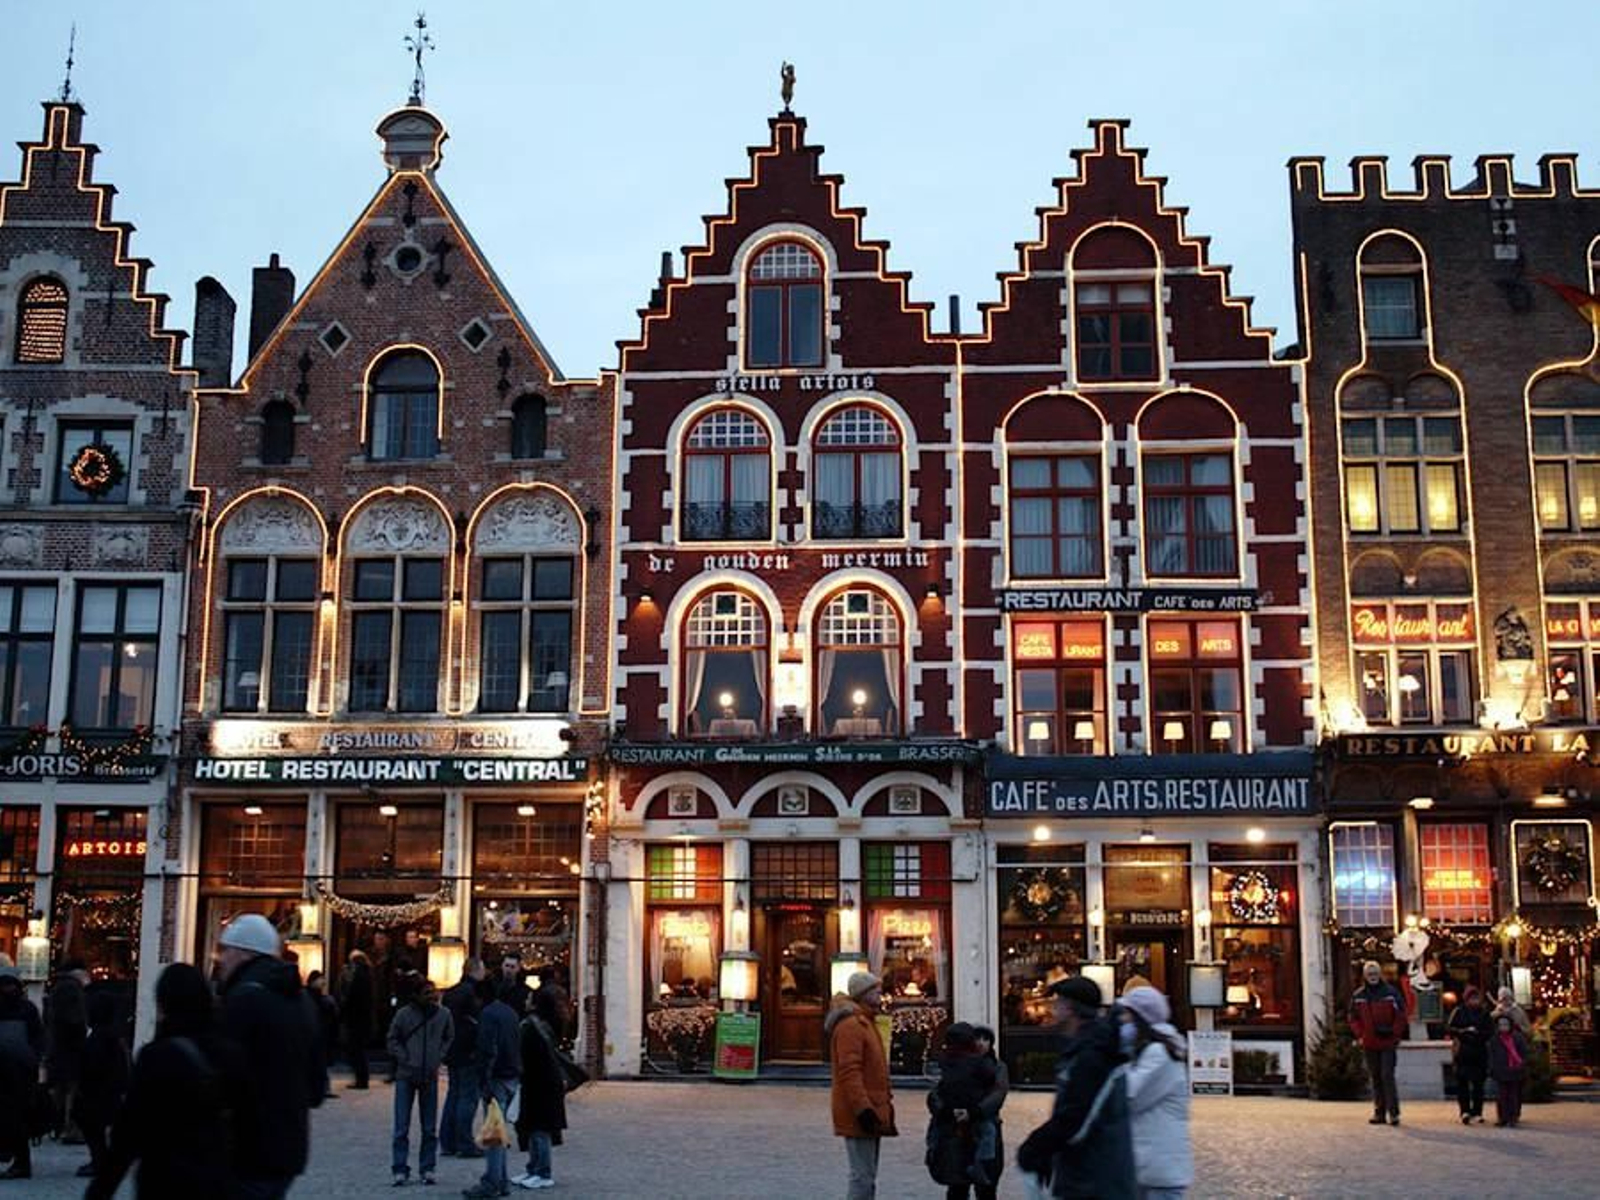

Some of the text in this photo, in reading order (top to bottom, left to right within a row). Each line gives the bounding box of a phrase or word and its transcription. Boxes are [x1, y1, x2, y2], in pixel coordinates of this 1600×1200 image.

[715, 374, 874, 390] stella artois
[649, 551, 929, 572] de gouden meermin
[1004, 591, 1142, 608] RESTAURANT
[1155, 639, 1233, 653] DES ARTS
[1349, 733, 1590, 754] RESTAURANT LA
[612, 749, 705, 763] RESTAURANT
[194, 759, 587, 781] HOTEL RESTAURANT "CENTRAL"
[1055, 797, 1088, 810] DES
[1164, 777, 1309, 809] RESTAURANT
[68, 842, 147, 856] ARTOIS
